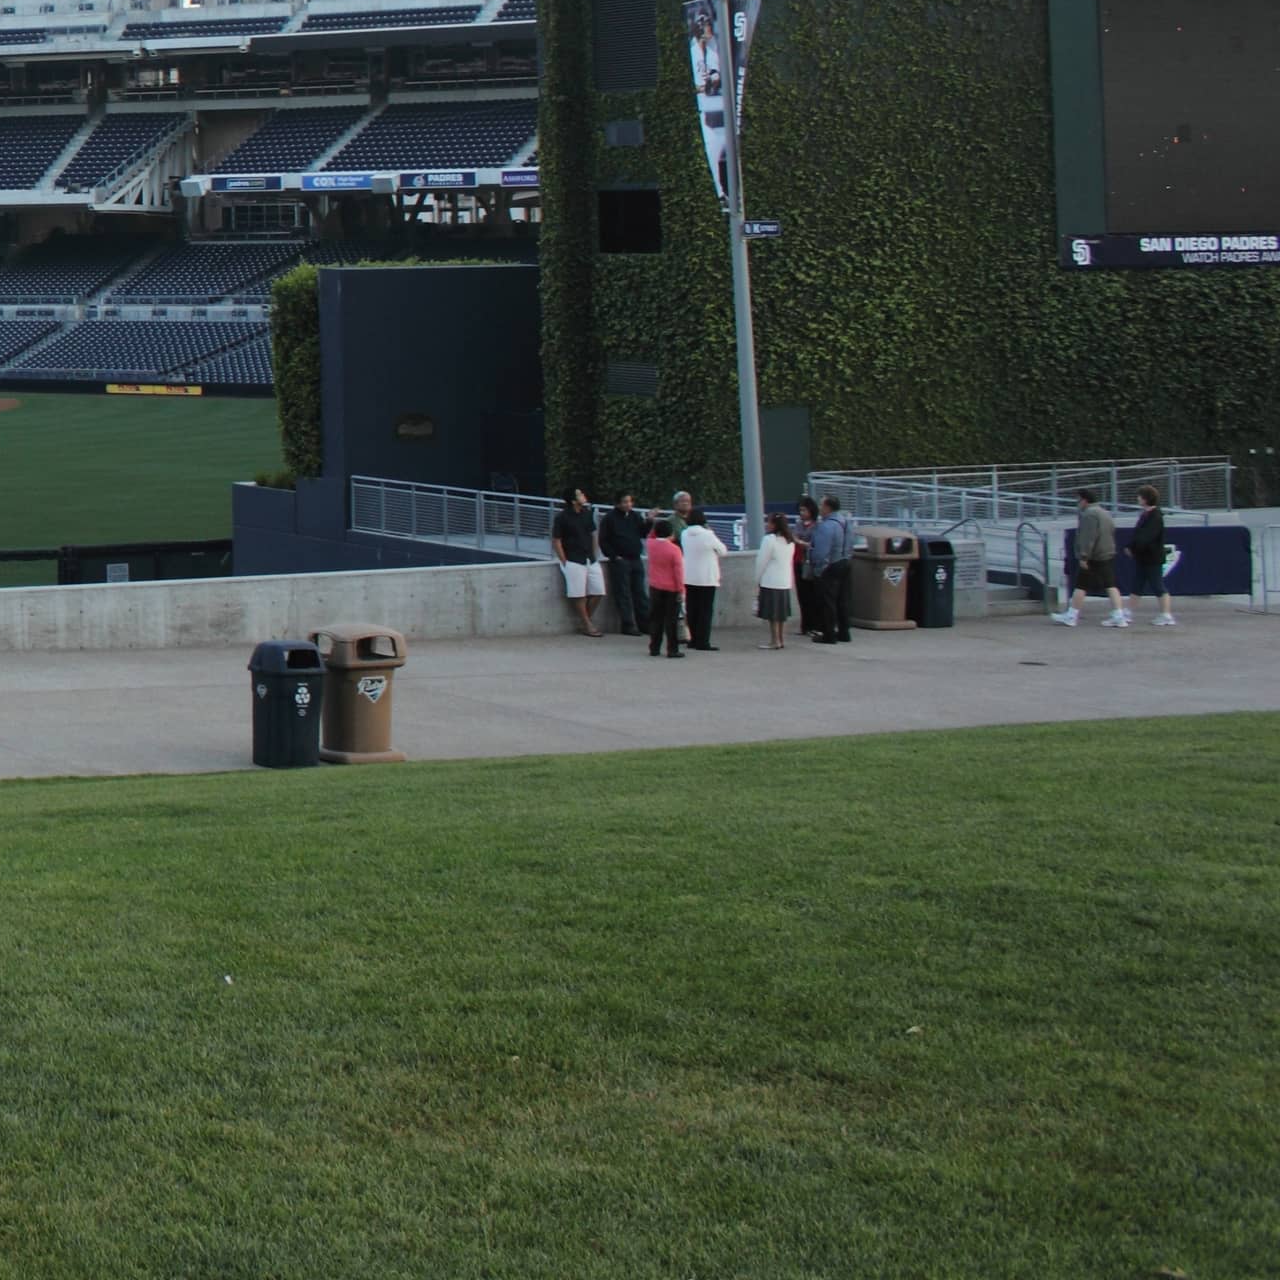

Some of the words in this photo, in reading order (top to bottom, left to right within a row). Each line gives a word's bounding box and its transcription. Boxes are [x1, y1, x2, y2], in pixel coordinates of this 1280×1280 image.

[312, 176, 336, 187] COX
[427, 173, 464, 182] PADRES
[1140, 238, 1172, 252] SAN
[1175, 237, 1218, 251] DIEGO
[1221, 236, 1279, 251] PADRES
[1182, 252, 1219, 264] WATCH
[1220, 251, 1260, 263] PADRES
